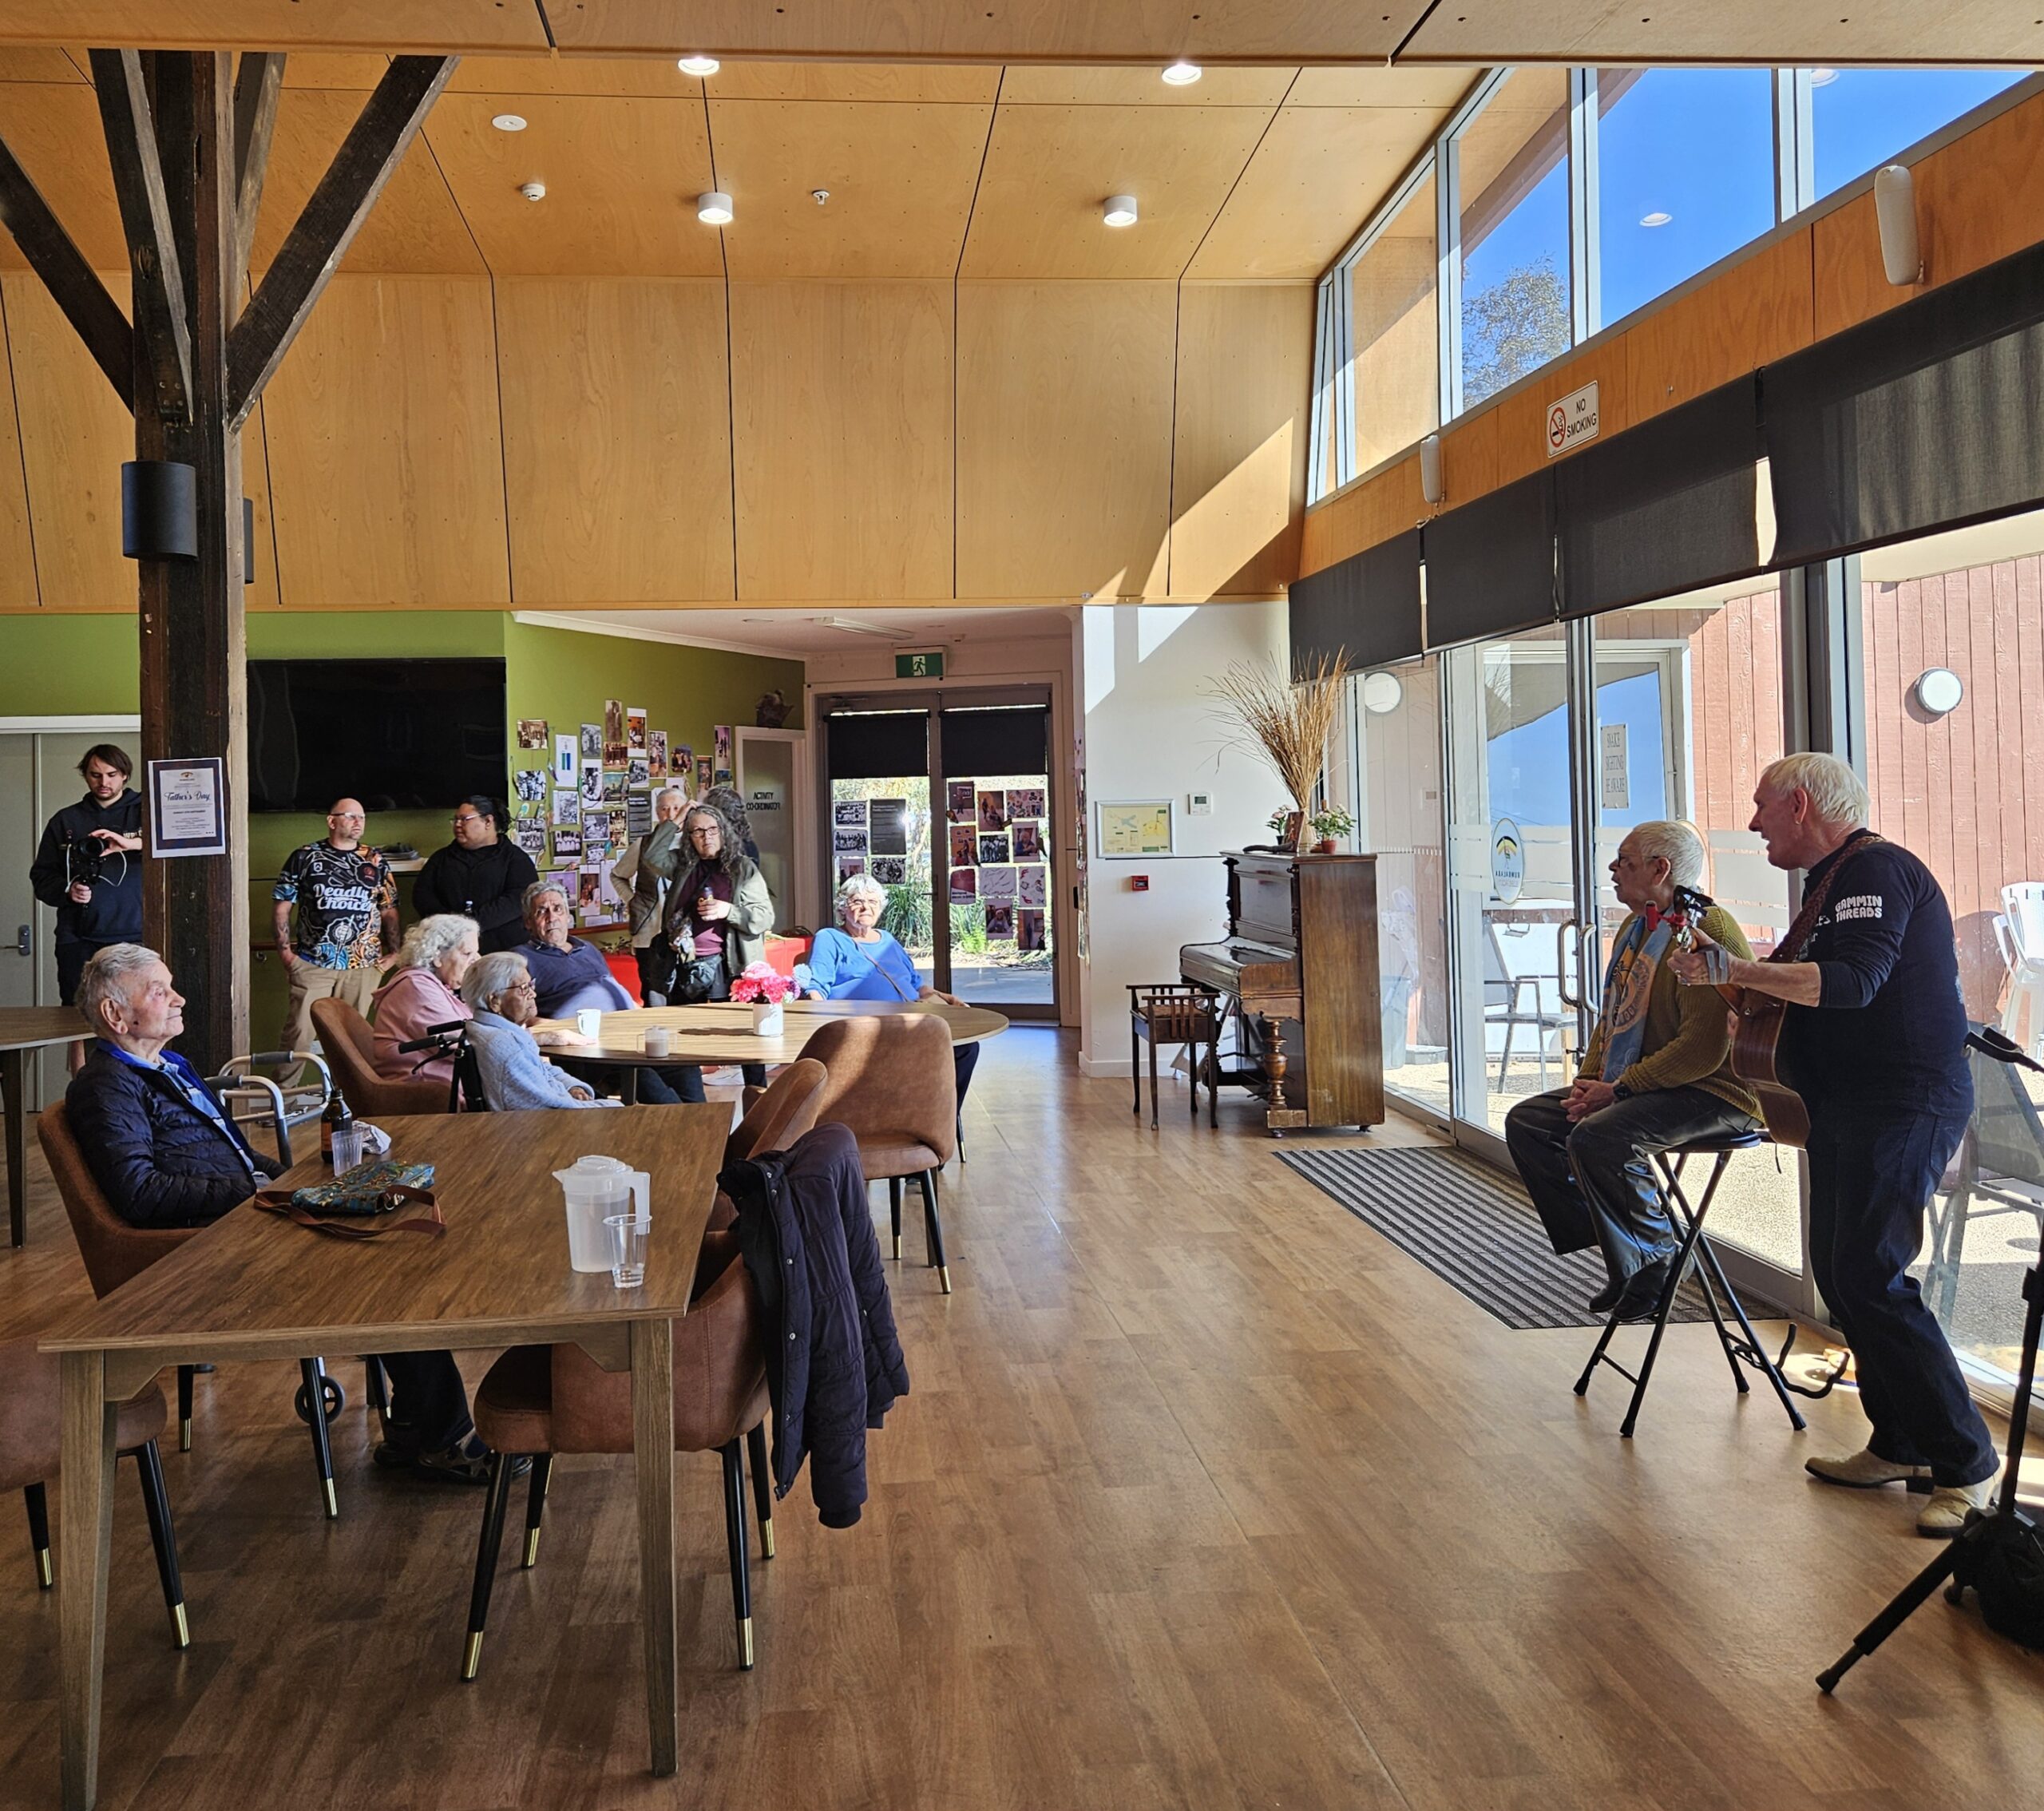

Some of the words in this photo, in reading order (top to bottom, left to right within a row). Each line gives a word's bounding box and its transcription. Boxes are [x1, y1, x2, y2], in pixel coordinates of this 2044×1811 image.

[1575, 398, 1586, 414] NO
[1567, 412, 1597, 438] SMOKING
[164, 791, 193, 802] Father's
[195, 791, 211, 802] Day
[753, 791, 774, 800] ACTIVITY
[312, 883, 369, 902] Deadly
[1835, 895, 1883, 912] GAMMIN
[1836, 907, 1883, 923] THREADS
